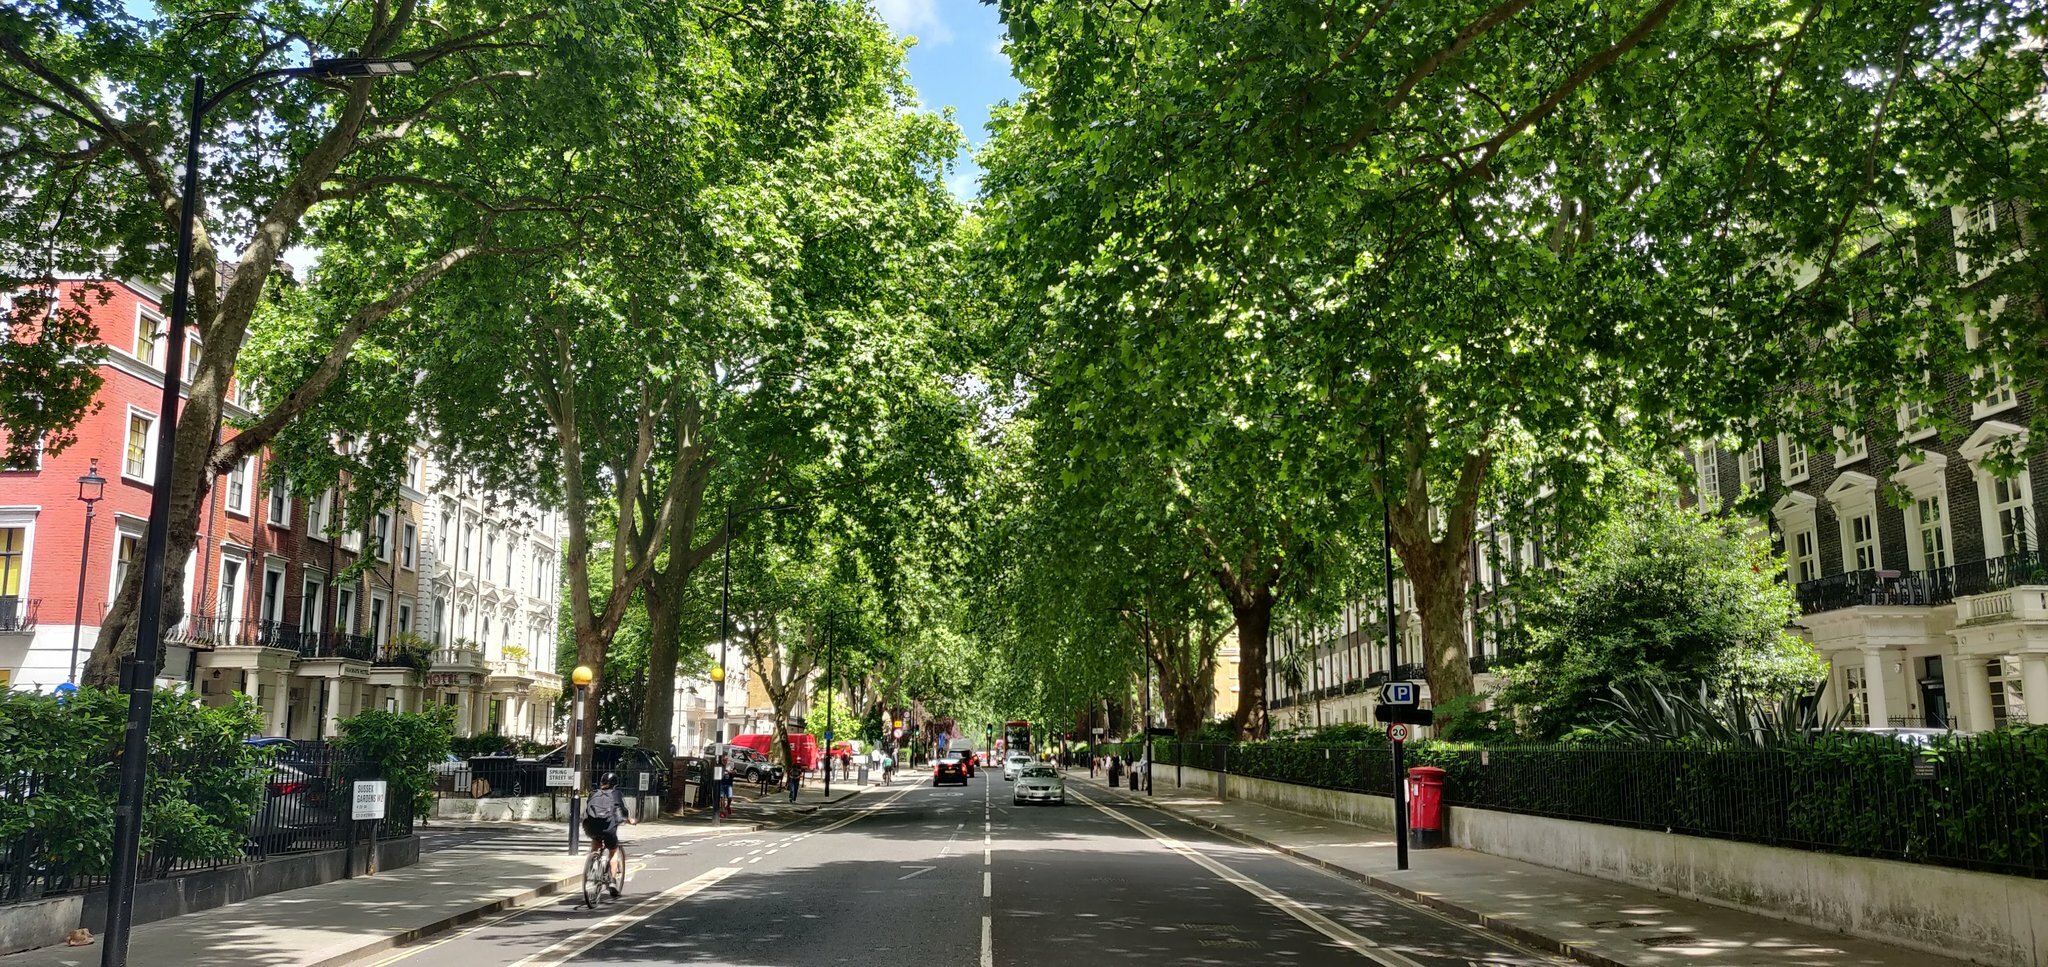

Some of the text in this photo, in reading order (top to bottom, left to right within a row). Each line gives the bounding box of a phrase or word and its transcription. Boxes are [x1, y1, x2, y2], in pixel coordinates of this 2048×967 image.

[1397, 687, 1408, 700] P
[1392, 728, 1405, 736] 20
[357, 785, 374, 793] SUSSEX
[357, 794, 376, 803] GARDENS
